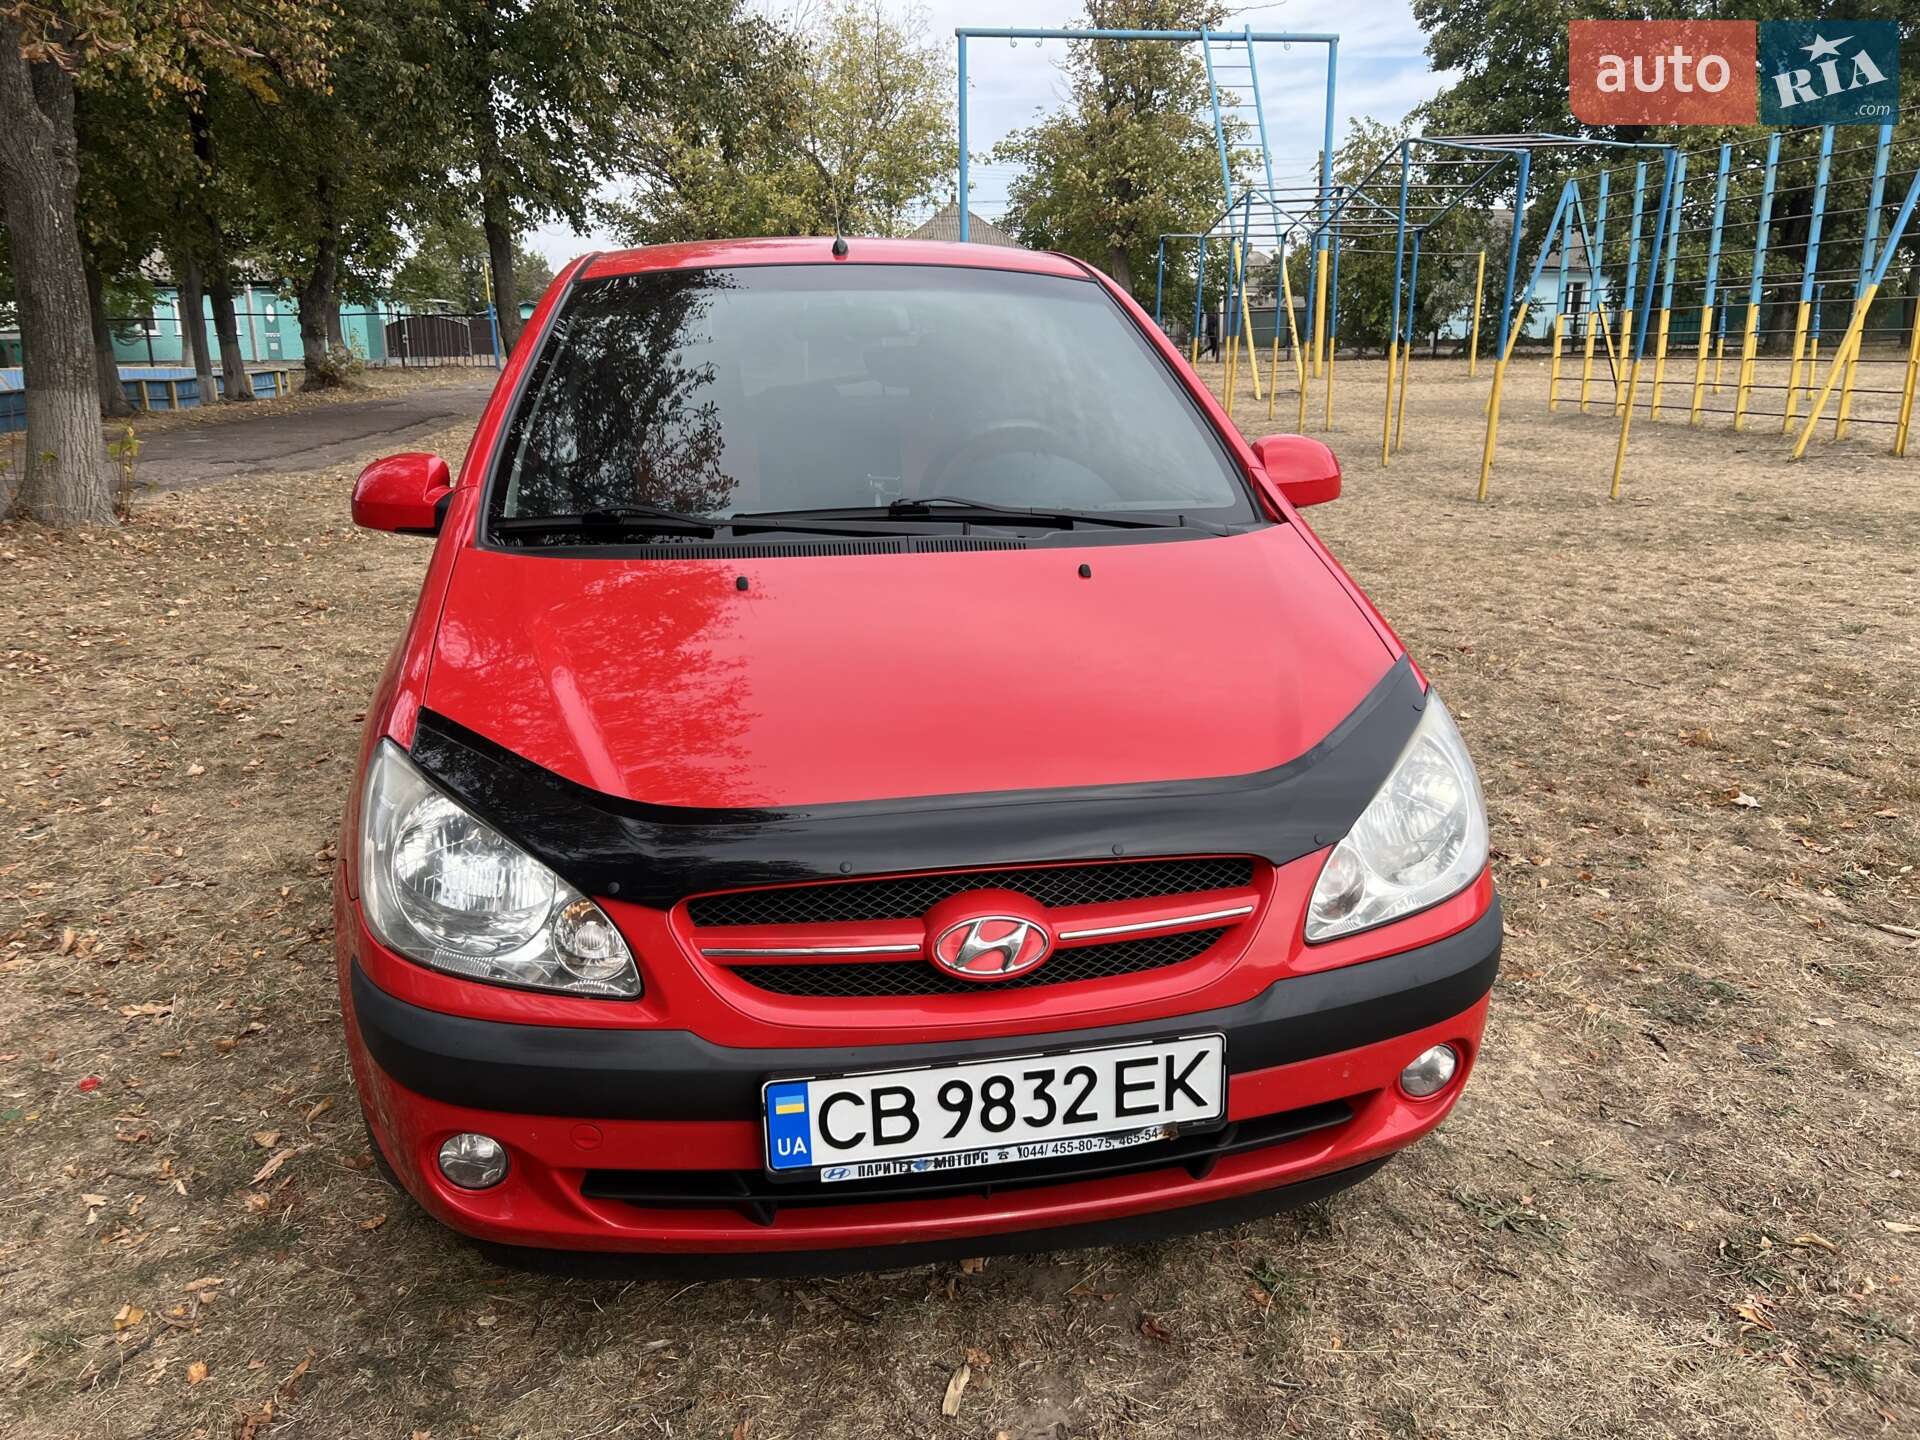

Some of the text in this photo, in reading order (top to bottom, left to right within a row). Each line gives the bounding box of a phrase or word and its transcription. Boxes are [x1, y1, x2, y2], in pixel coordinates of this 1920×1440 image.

[818, 1050, 1209, 1149] CB 9832 EK
[777, 1137, 807, 1157] UA
